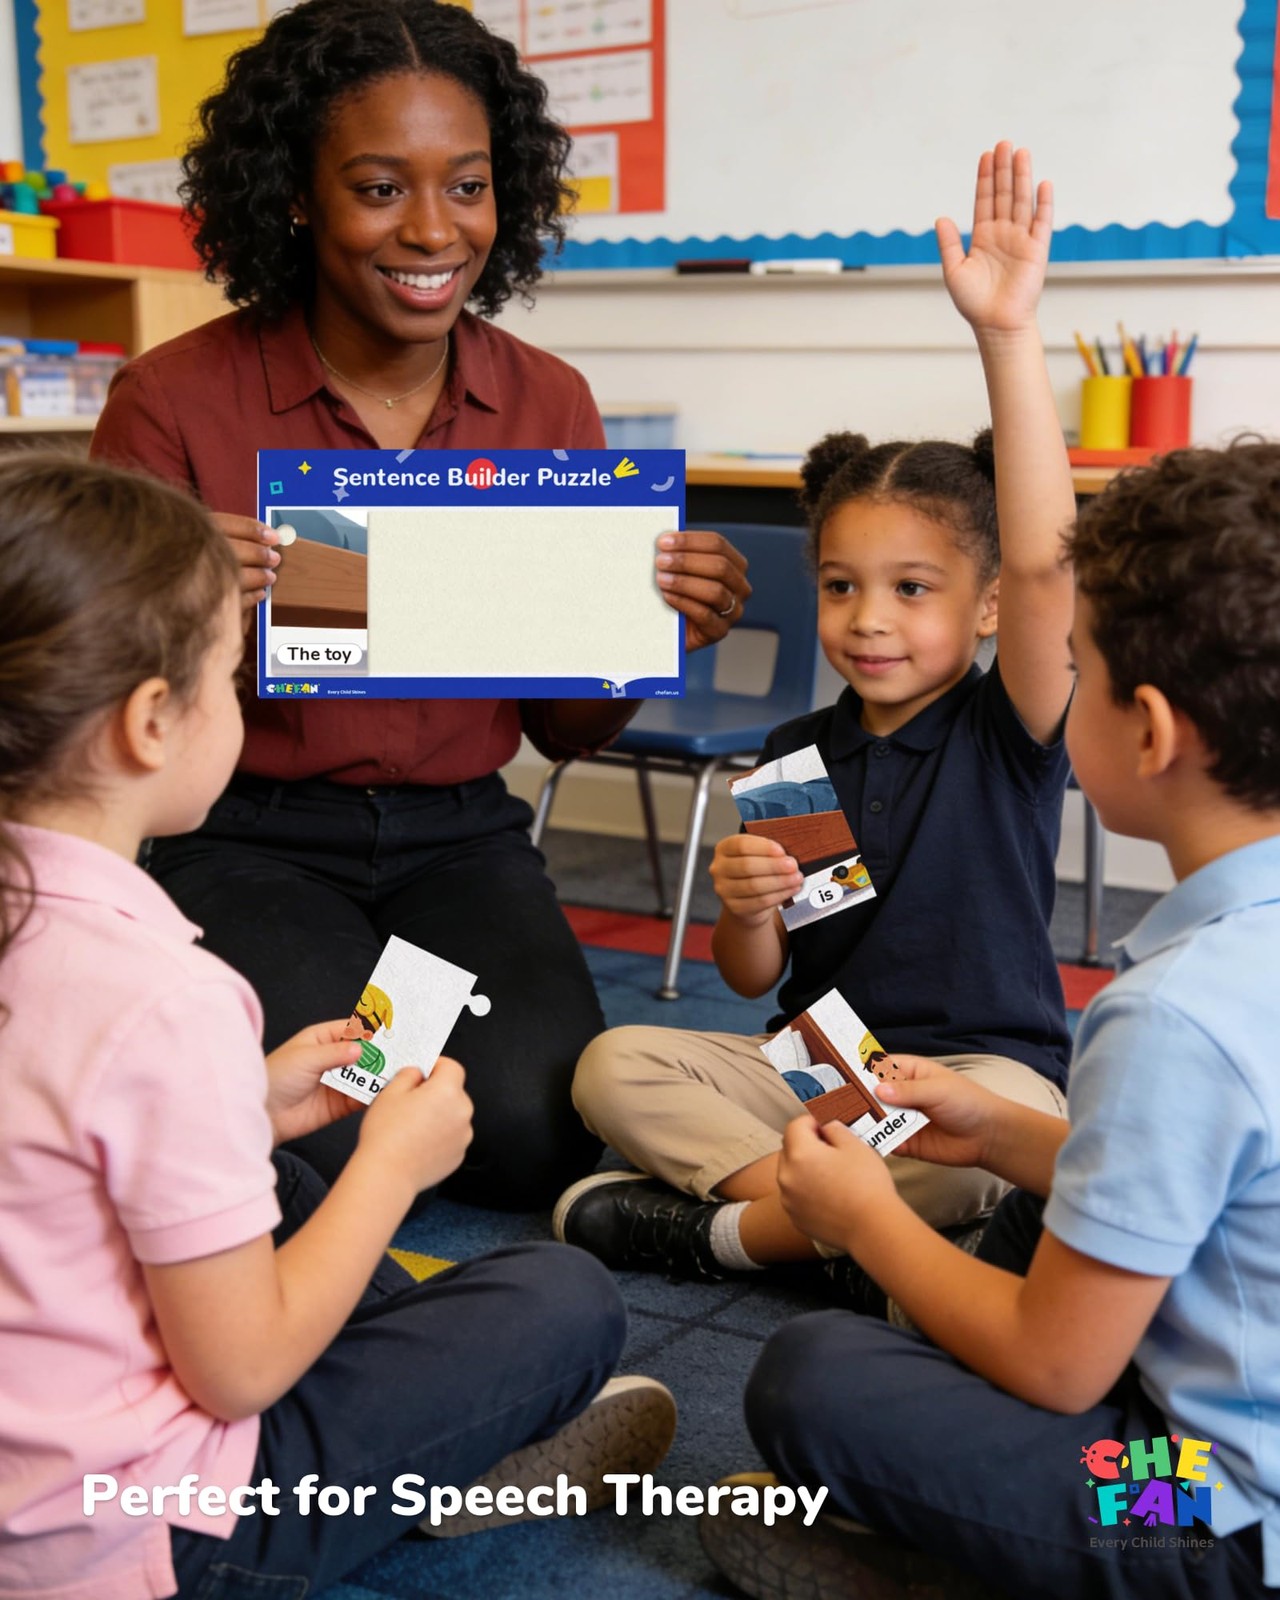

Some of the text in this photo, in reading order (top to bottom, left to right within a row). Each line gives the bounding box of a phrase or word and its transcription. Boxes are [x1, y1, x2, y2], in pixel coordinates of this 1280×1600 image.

[333, 467, 612, 487] Sentence Builder Puzzle
[287, 646, 352, 664] The toy
[266, 682, 319, 694] CHEFAN
[818, 888, 834, 903] is
[340, 1065, 366, 1087] the
[866, 1112, 908, 1148] under
